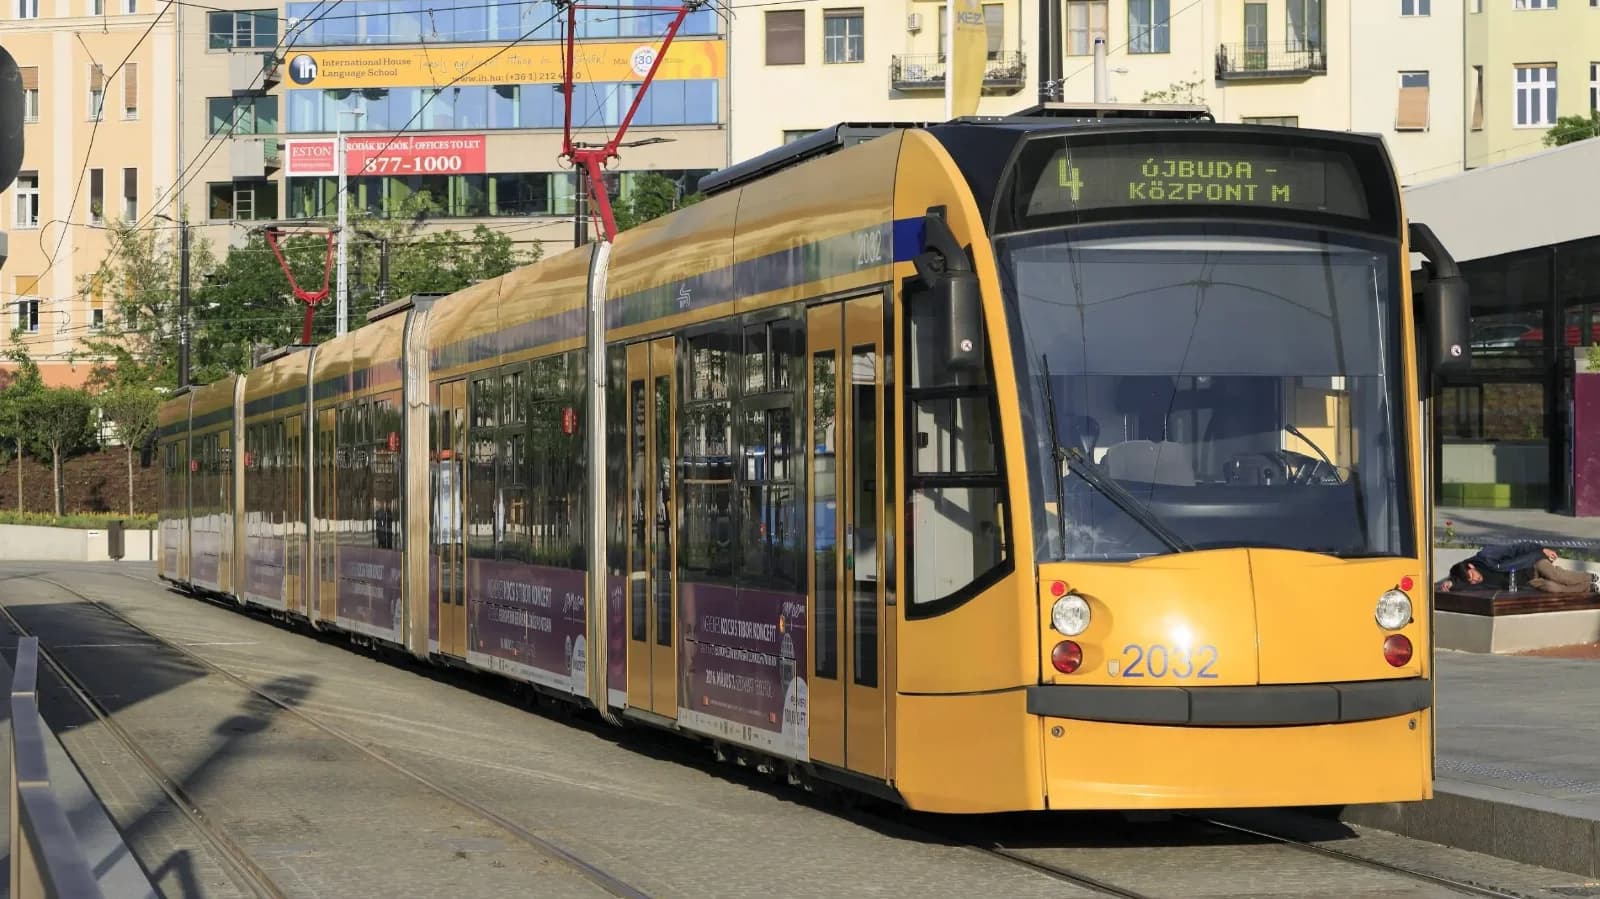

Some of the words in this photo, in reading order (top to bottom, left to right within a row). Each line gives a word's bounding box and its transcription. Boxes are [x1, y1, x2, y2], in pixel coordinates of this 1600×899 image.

[300, 59, 316, 79] ih
[322, 58, 382, 67] International
[383, 57, 411, 66] House
[322, 69, 366, 79] Language
[367, 68, 398, 77] School
[539, 72, 556, 80] 212
[292, 145, 332, 157] ESTON
[346, 140, 375, 152] RODÁK
[415, 141, 449, 150] OFFICES
[450, 140, 462, 149] TO
[463, 140, 480, 149] LET
[364, 156, 462, 173] 877-1000
[1142, 158, 1252, 179] ÚJBUDA
[1058, 158, 1084, 201] 4
[1129, 181, 1258, 201] KÖZPONT
[1271, 184, 1290, 202] M
[857, 230, 882, 265] 2032
[1122, 643, 1218, 679] 2032
